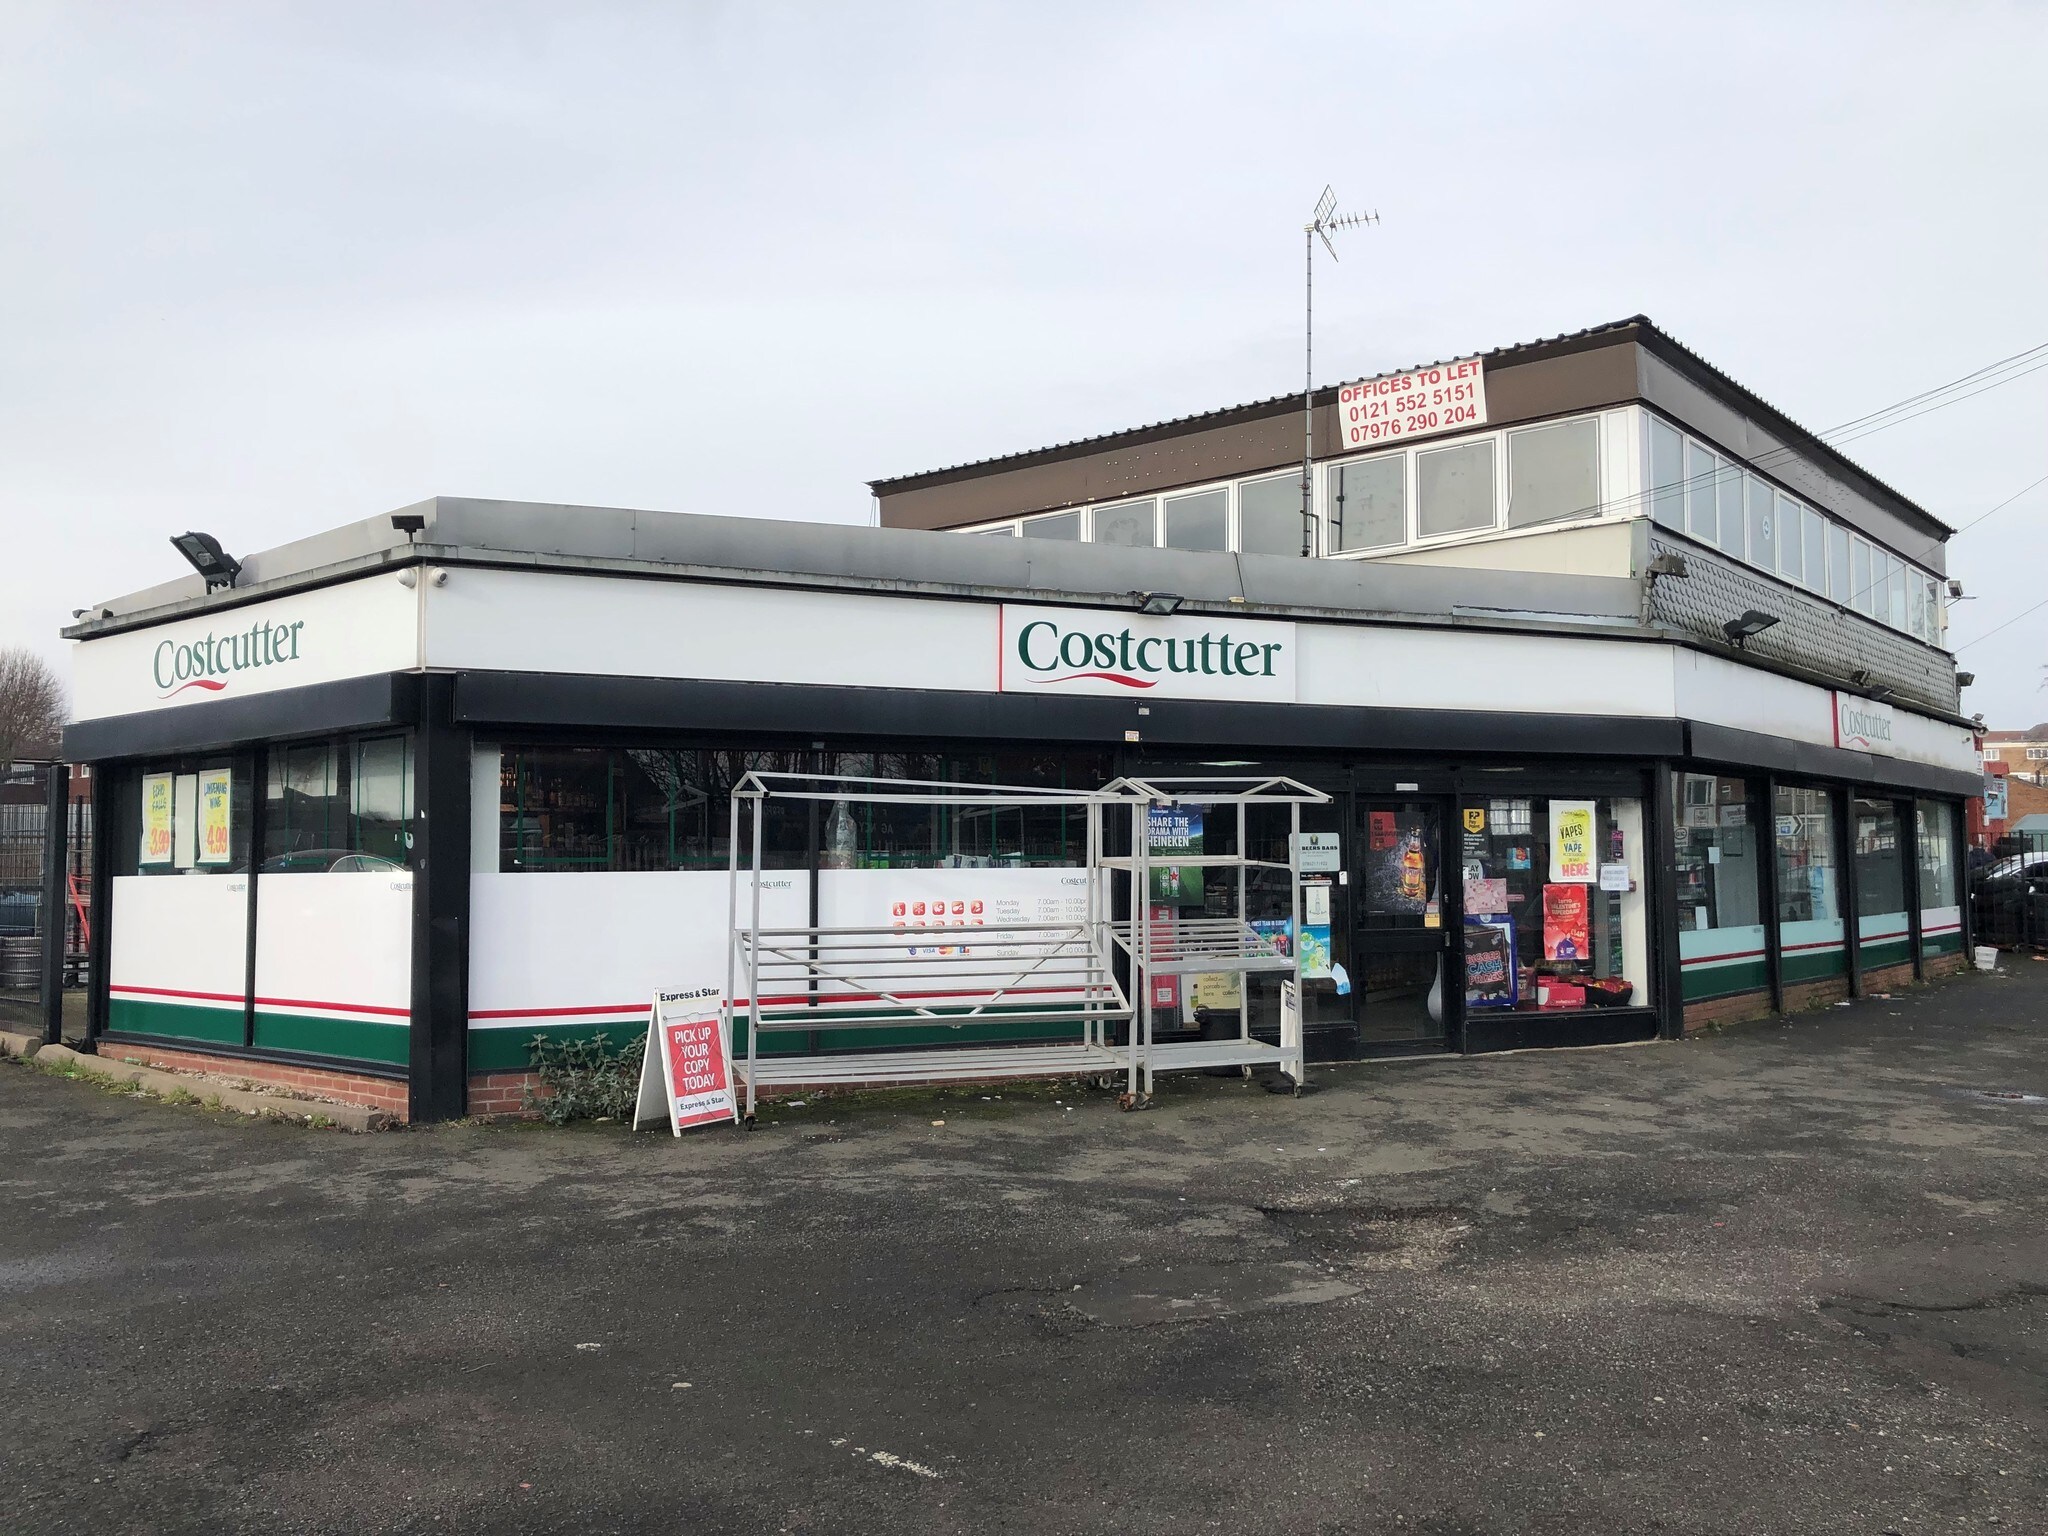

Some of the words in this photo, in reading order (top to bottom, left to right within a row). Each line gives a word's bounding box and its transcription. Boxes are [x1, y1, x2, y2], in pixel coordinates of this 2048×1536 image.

[1340, 376, 1412, 402] OFFICES
[1417, 370, 1440, 386] TO
[1447, 362, 1480, 381] LET
[1350, 400, 1388, 422] 0121
[1396, 392, 1426, 412] 552
[1433, 382, 1474, 405] 5151
[1351, 419, 1400, 442] 07976
[1407, 412, 1438, 432] 290
[1444, 404, 1476, 424] 204
[154, 619, 304, 690] Costcutter
[1018, 620, 1282, 676] Costcutter
[1840, 702, 1892, 742] Costcutter
[1148, 817, 1172, 826] SHARE
[1174, 817, 1188, 827] THE
[1172, 828, 1188, 836] WITH
[1560, 824, 1583, 839] VAPES
[150, 828, 170, 856] 3.99
[207, 825, 227, 854] 4.99
[1148, 836, 1189, 846] HEINEKEN
[1564, 844, 1582, 852] VAPE
[1562, 862, 1590, 877] HERE
[1467, 960, 1503, 974] CASH
[1469, 971, 1504, 985] PRIZES
[660, 992, 694, 1002] Express
[702, 988, 720, 997] Star
[675, 1028, 697, 1044] PICK
[698, 1027, 711, 1040] UP
[681, 1043, 709, 1057] YOUR
[684, 1058, 710, 1074] COPY
[683, 1073, 715, 1090] TODAY
[680, 1102, 706, 1110] Express
[711, 1096, 724, 1104] Star
